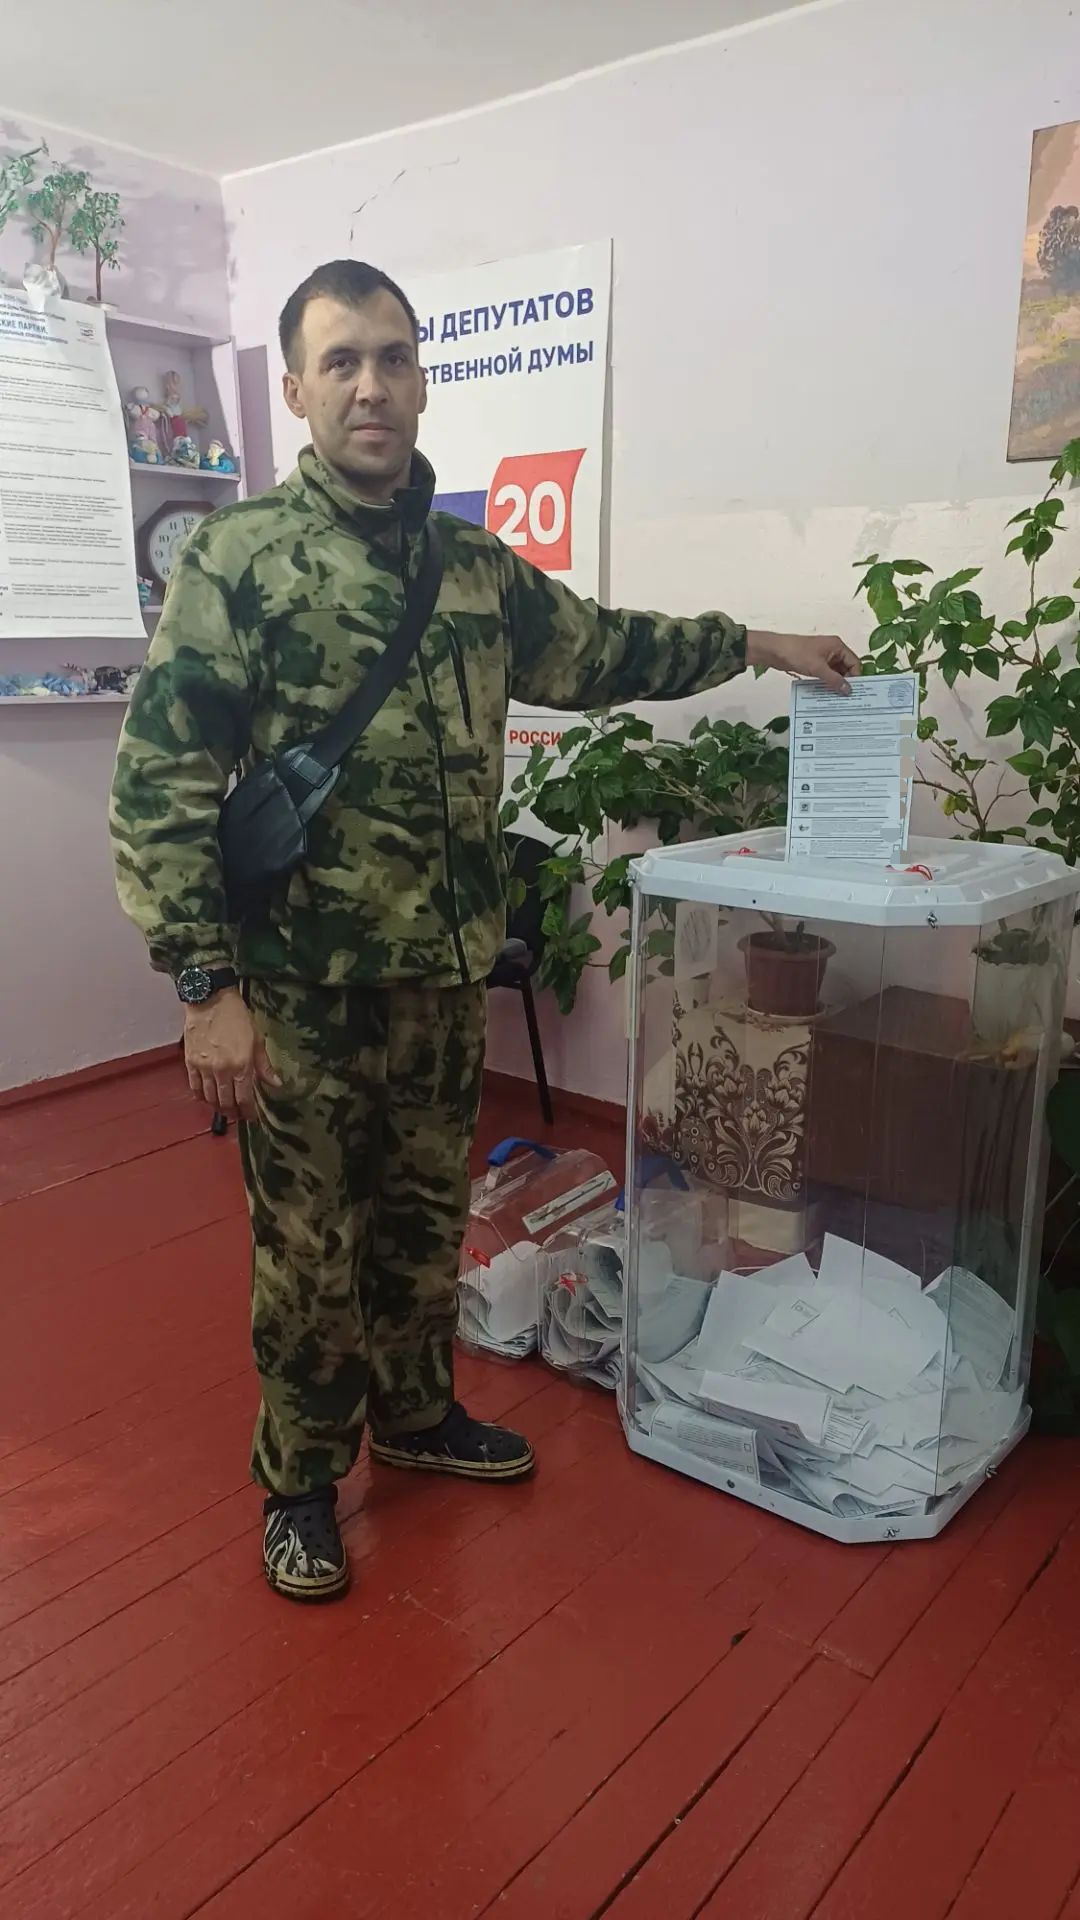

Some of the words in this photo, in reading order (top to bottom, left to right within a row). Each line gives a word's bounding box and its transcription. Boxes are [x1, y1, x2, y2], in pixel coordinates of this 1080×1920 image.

[441, 287, 594, 343] ДЕПУТАТОВ
[528, 340, 594, 374] ДУМЫ
[494, 480, 566, 547] 20
